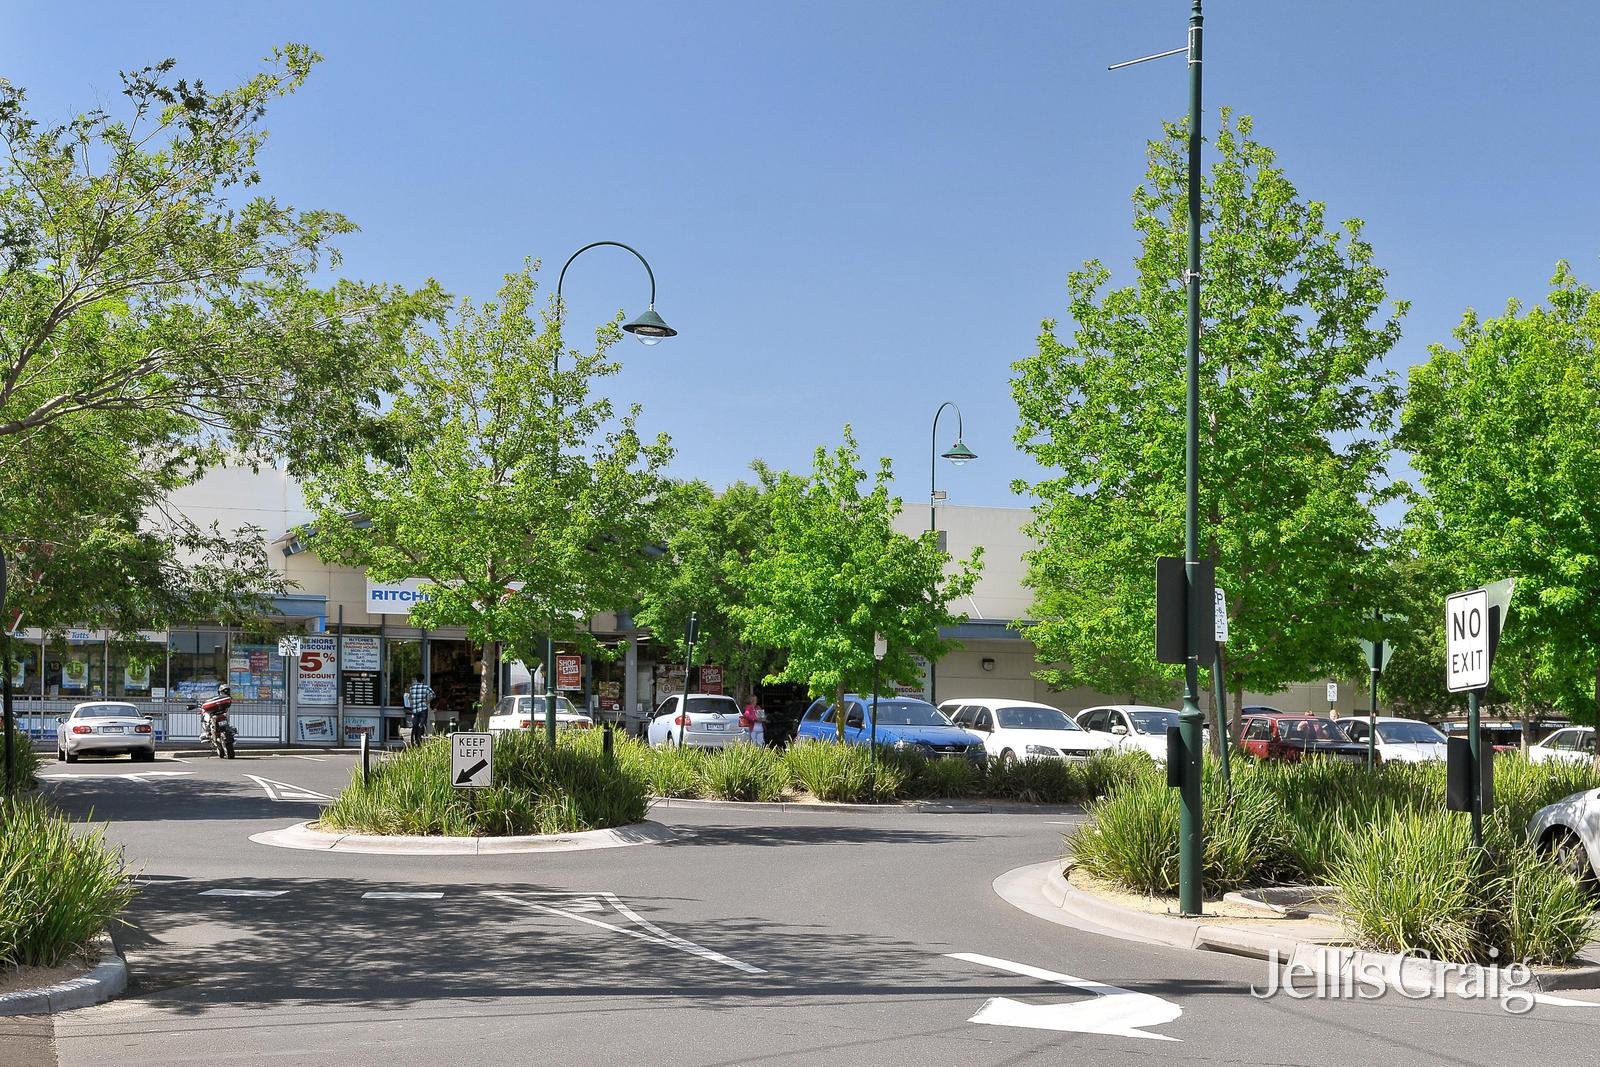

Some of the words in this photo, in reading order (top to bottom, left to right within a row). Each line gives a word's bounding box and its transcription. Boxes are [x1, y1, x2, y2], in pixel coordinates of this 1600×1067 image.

[1453, 608, 1481, 641] NO
[71, 631, 89, 639] Tatts
[558, 659, 576, 667] SHOP
[1452, 649, 1484, 674] EXIT
[459, 738, 485, 746] KEEP
[460, 749, 484, 757] LEFT
